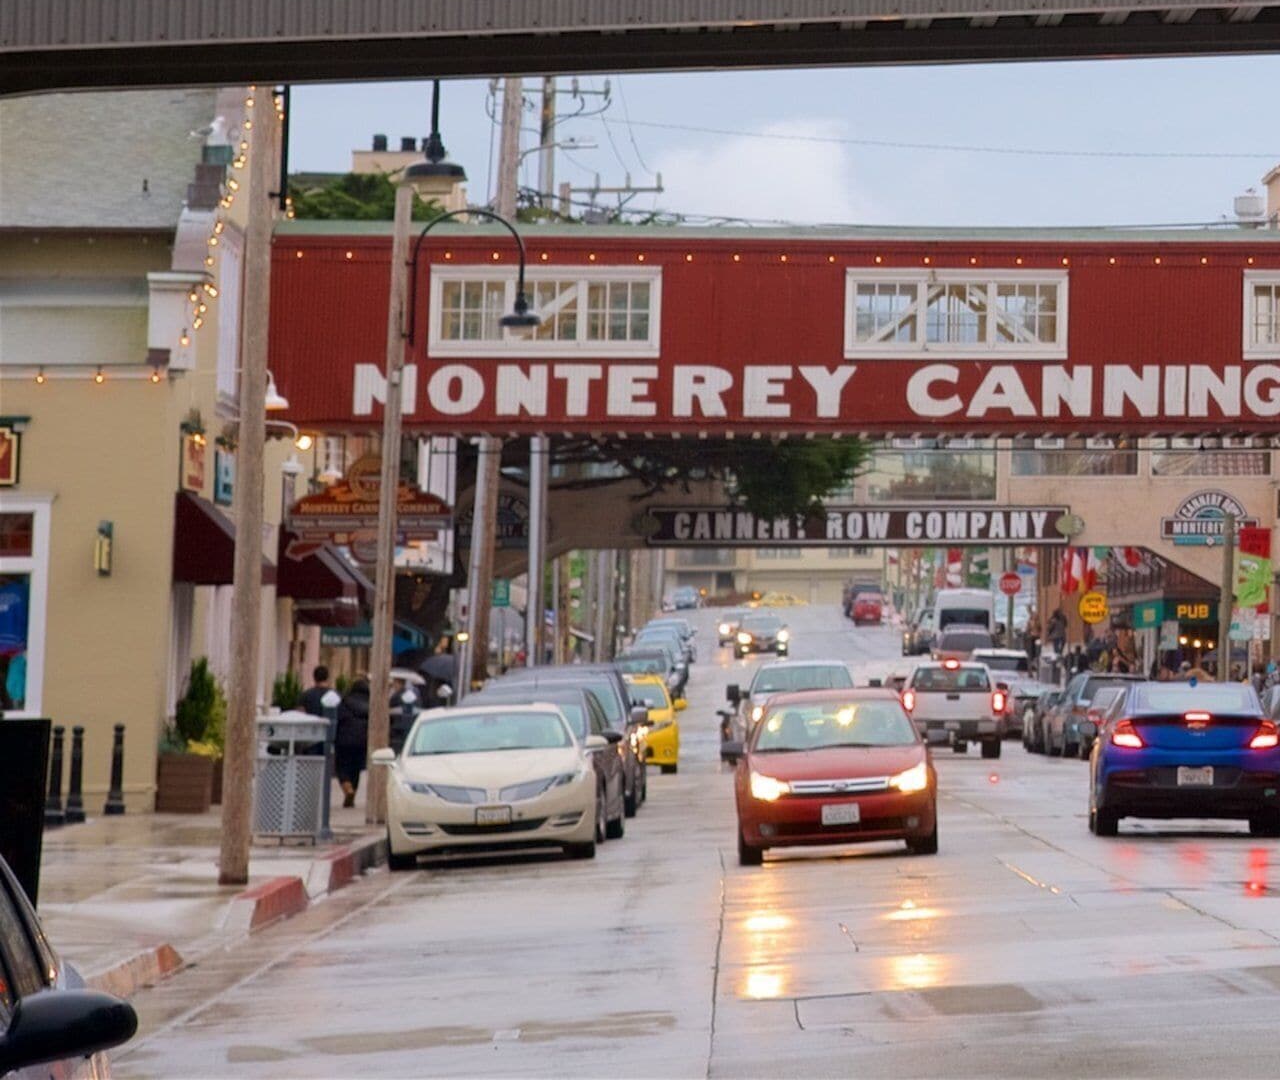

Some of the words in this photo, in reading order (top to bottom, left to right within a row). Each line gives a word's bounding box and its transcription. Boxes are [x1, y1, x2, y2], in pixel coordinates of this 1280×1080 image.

[352, 363, 857, 418] MONTEREY
[1181, 493, 1223, 518] CANNERY
[826, 512, 890, 540] ROW
[905, 511, 1048, 539] COMPANY
[1173, 522, 1225, 533] MONTEREY
[1000, 579, 1021, 589] STOP
[1177, 604, 1209, 619] PUB
